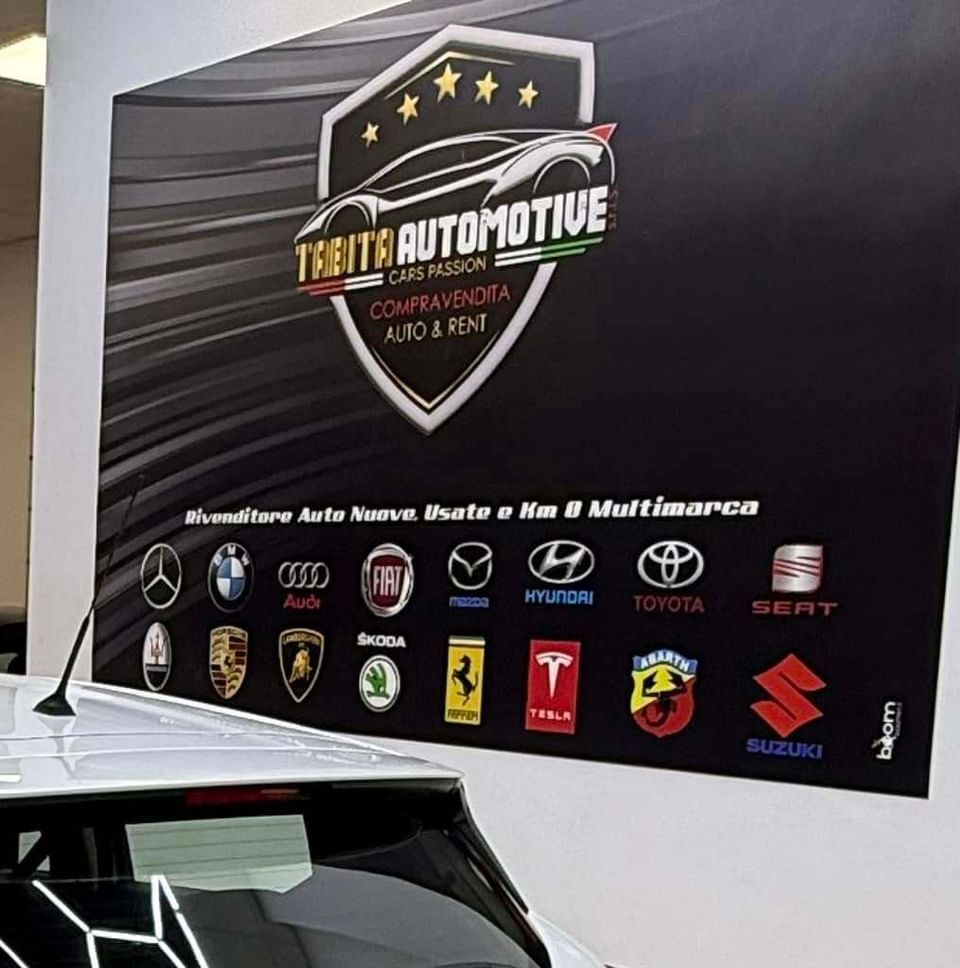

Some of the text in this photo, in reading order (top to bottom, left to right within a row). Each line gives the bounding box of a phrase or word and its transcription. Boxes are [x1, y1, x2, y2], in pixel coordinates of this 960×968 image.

[295, 228, 394, 282] TABITA
[397, 186, 608, 266] AUTOMOTIVE
[388, 256, 487, 285] CARS PASSION
[369, 284, 511, 320] COMPRAVENDITA
[384, 313, 488, 344] AUTO & RENT
[185, 507, 293, 525] Rivenditore
[297, 507, 345, 523] Auto
[424, 503, 491, 521] Usate
[497, 505, 513, 520] e
[519, 502, 557, 519] Km
[588, 496, 760, 518] Multimarca
[372, 565, 403, 596] FIAT
[283, 594, 321, 609] Audi
[525, 589, 594, 605] HYUNDAI
[634, 595, 705, 613] TOYOTA
[751, 600, 838, 616] SEAT
[640, 650, 690, 672] ABARTH
[529, 708, 571, 721] TESLA
[746, 738, 823, 760] SUZUKI
